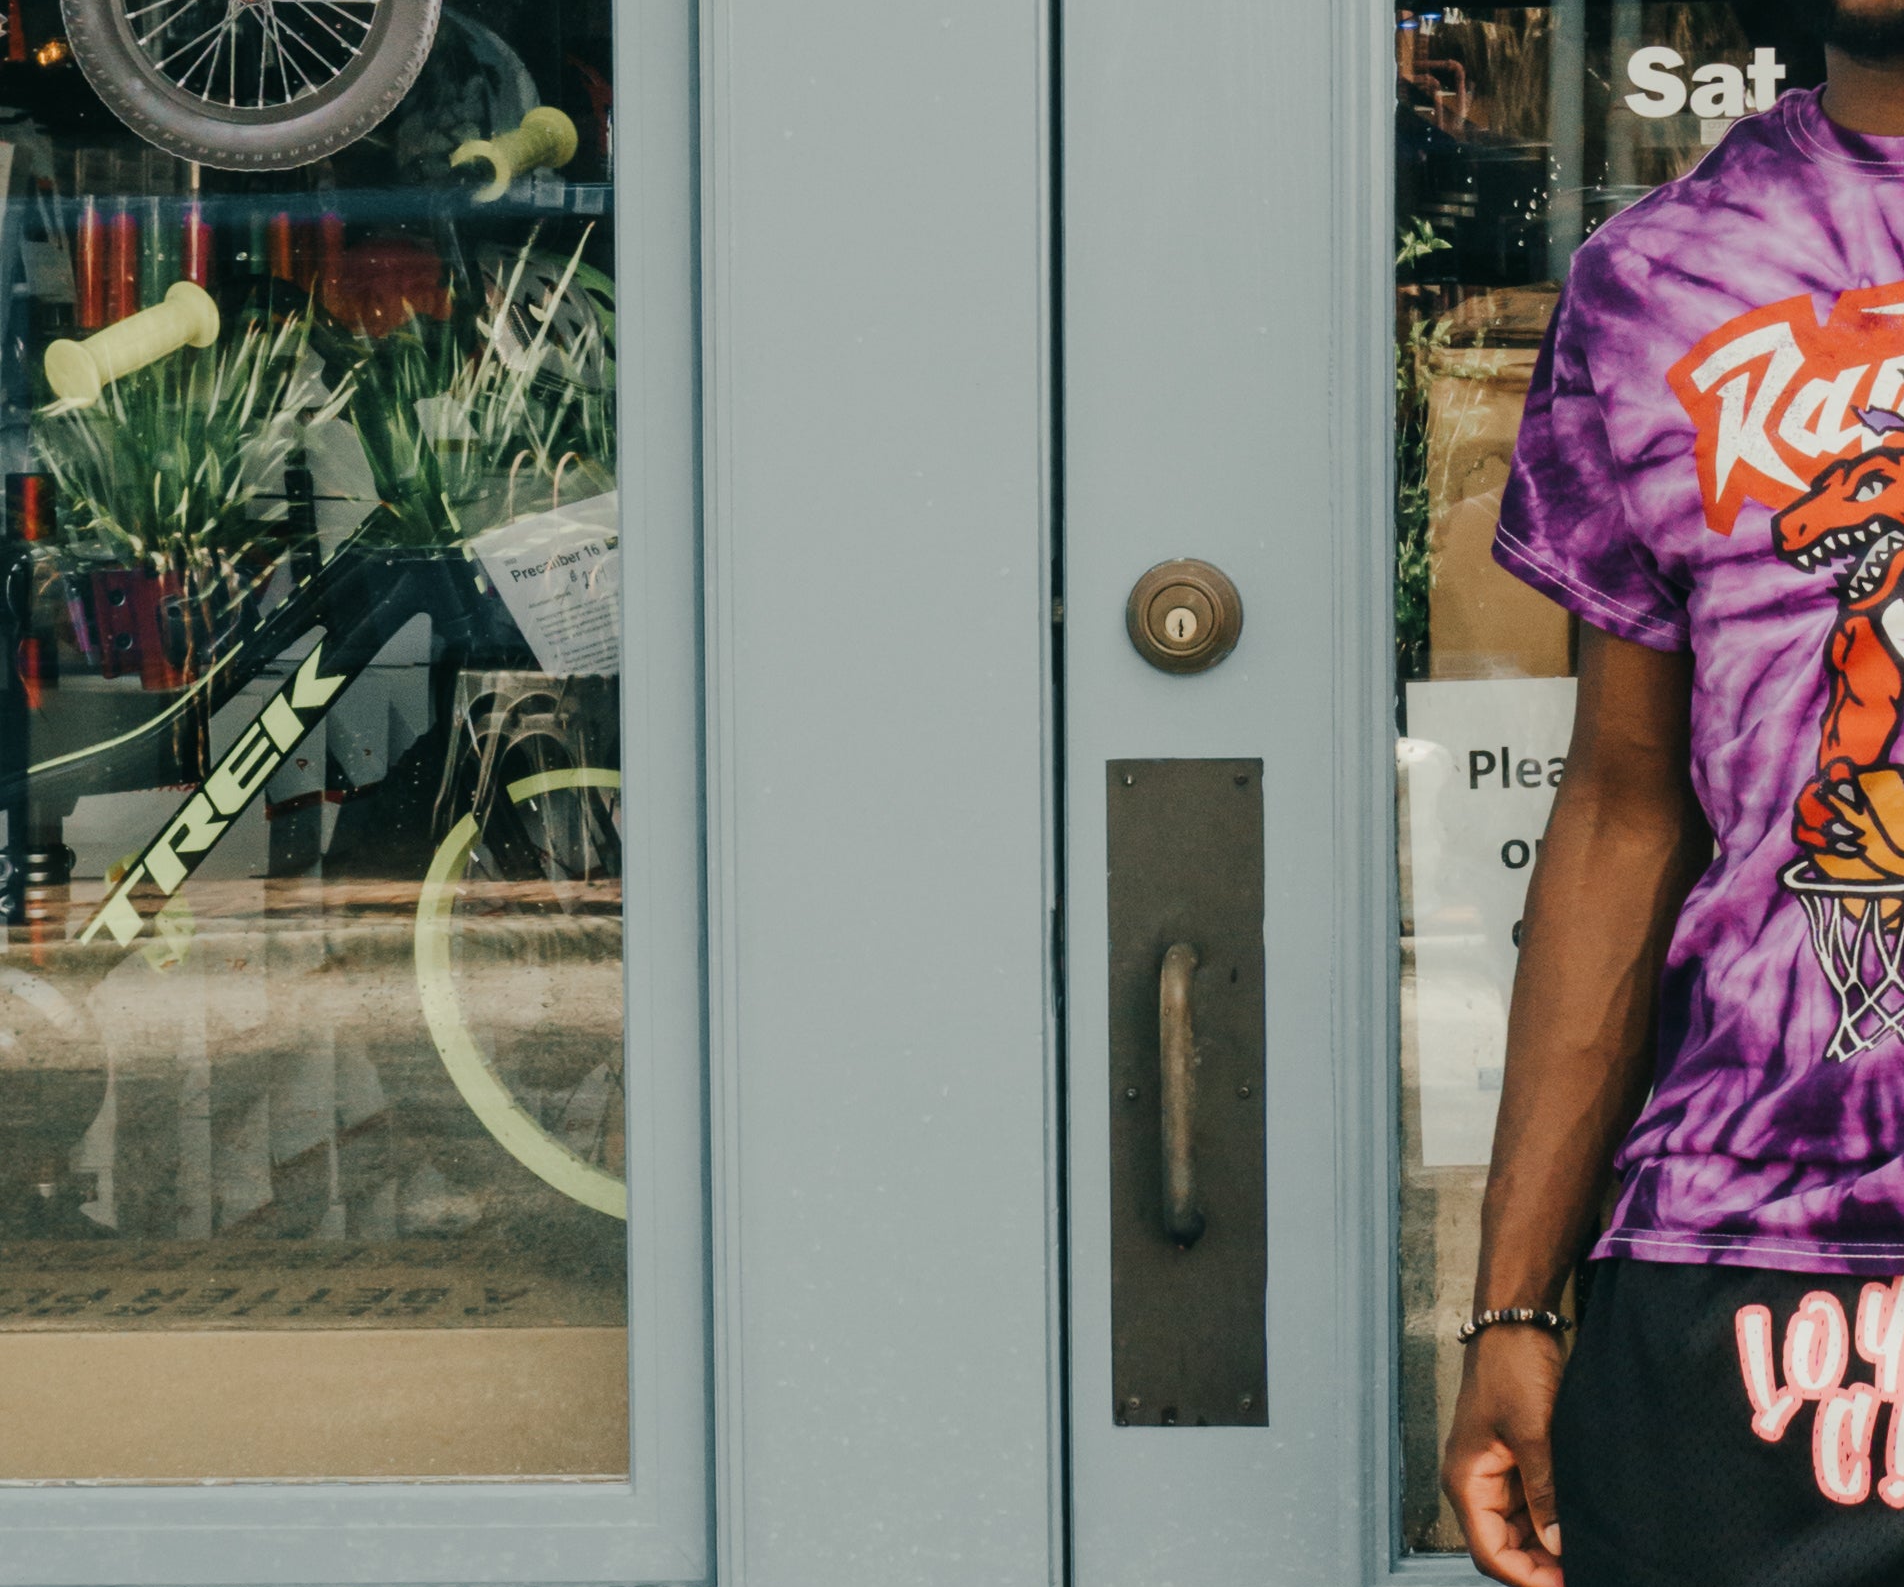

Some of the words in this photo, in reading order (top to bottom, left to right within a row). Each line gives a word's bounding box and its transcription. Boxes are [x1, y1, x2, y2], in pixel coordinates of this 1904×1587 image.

[1624, 46, 1787, 119] Sat
[583, 543, 601, 558] 16
[80, 642, 347, 948] TREK
[1468, 746, 1567, 790] Plea
